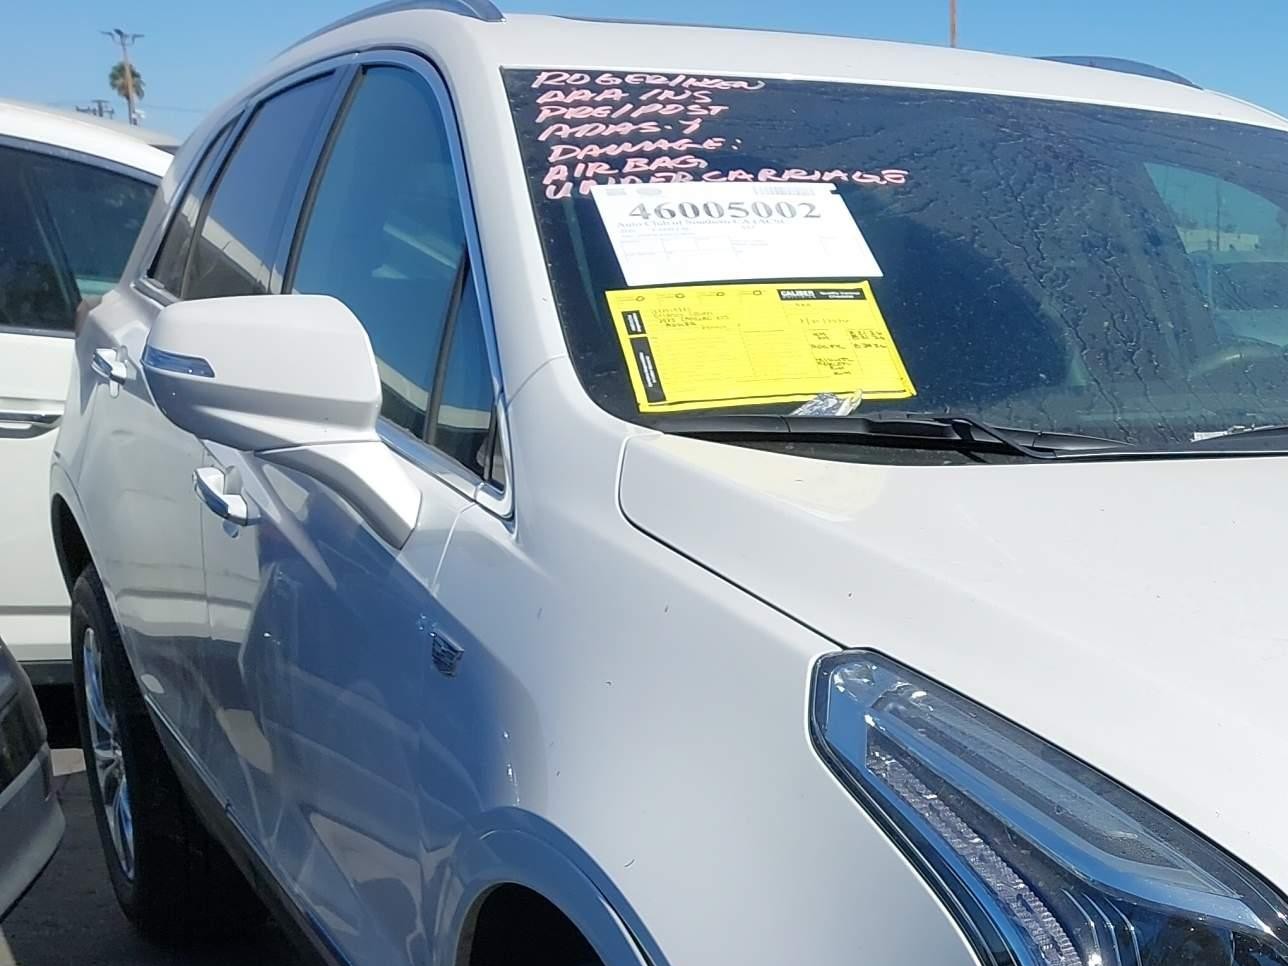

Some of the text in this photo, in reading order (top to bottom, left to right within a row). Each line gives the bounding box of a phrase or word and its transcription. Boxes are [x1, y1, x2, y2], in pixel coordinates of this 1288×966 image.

[535, 87, 713, 104] AAA INS
[535, 102, 730, 123] PRE/POST
[542, 154, 709, 185] AIR BAG
[628, 200, 822, 220] 46005002
